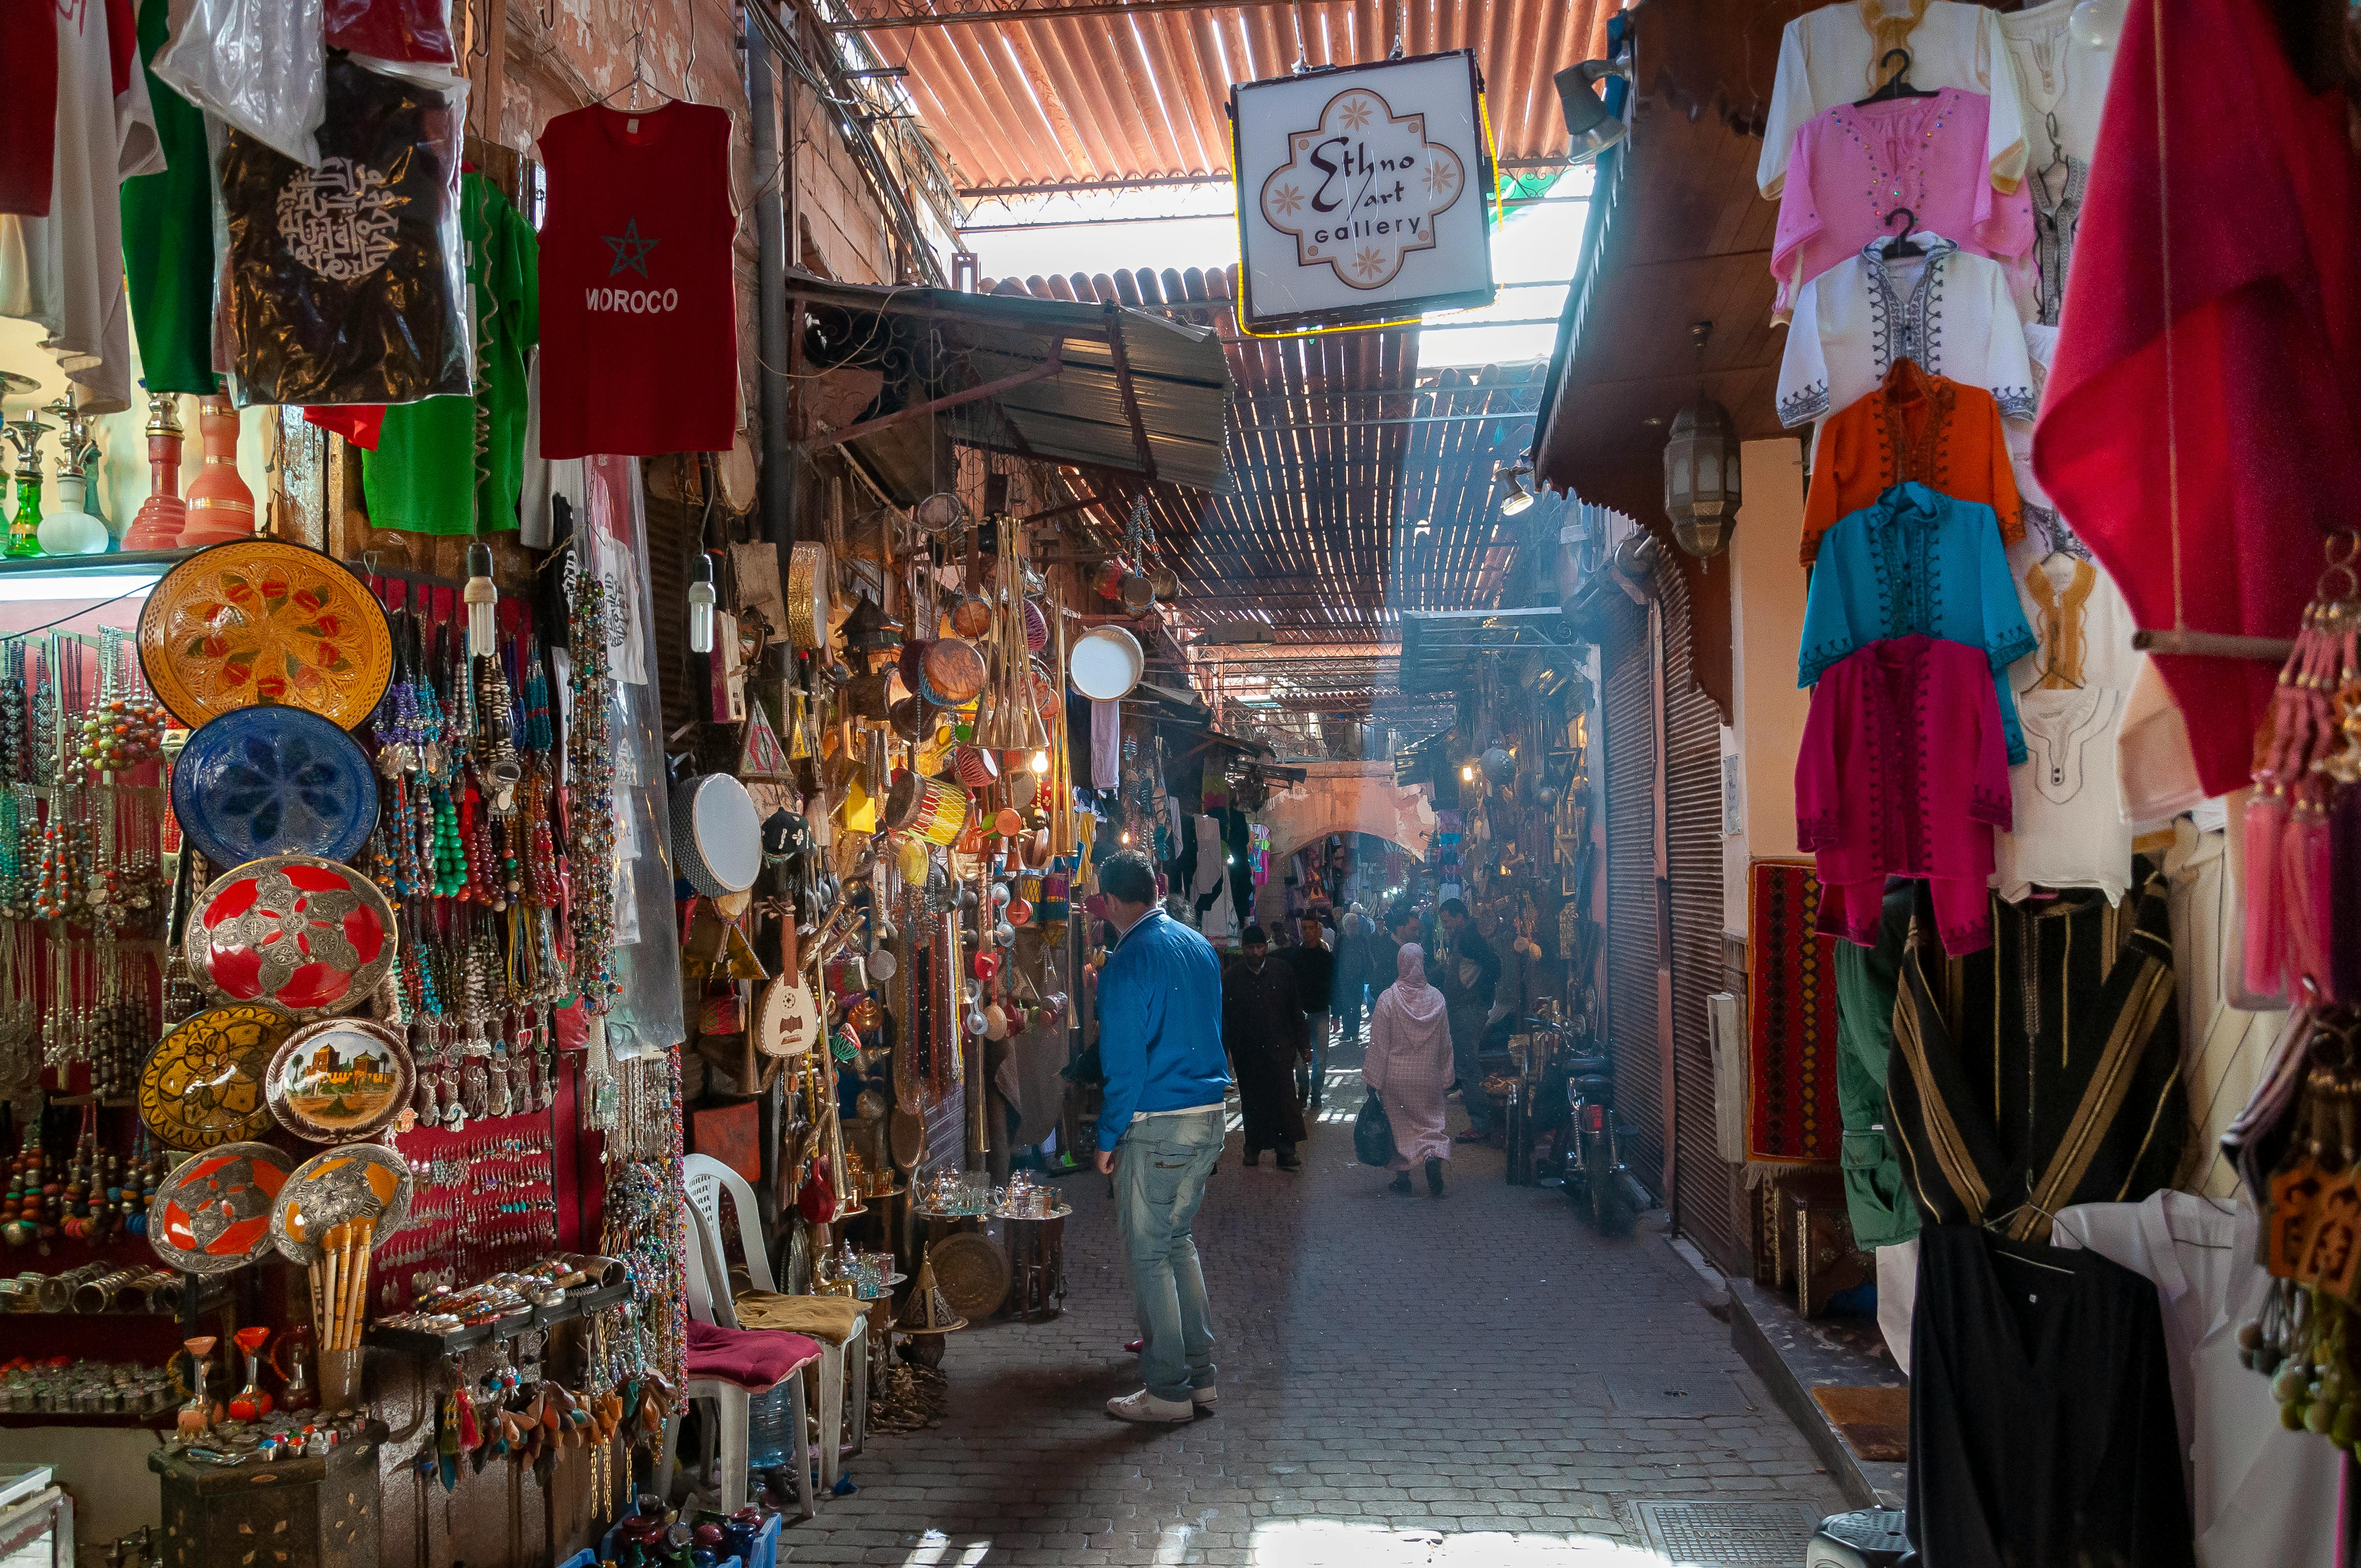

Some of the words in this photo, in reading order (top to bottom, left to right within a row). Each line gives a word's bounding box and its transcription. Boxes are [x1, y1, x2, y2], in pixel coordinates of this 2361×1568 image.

[1310, 137, 1414, 221] Ethno
[1364, 181, 1404, 207] art
[1315, 217, 1420, 244] Gallery
